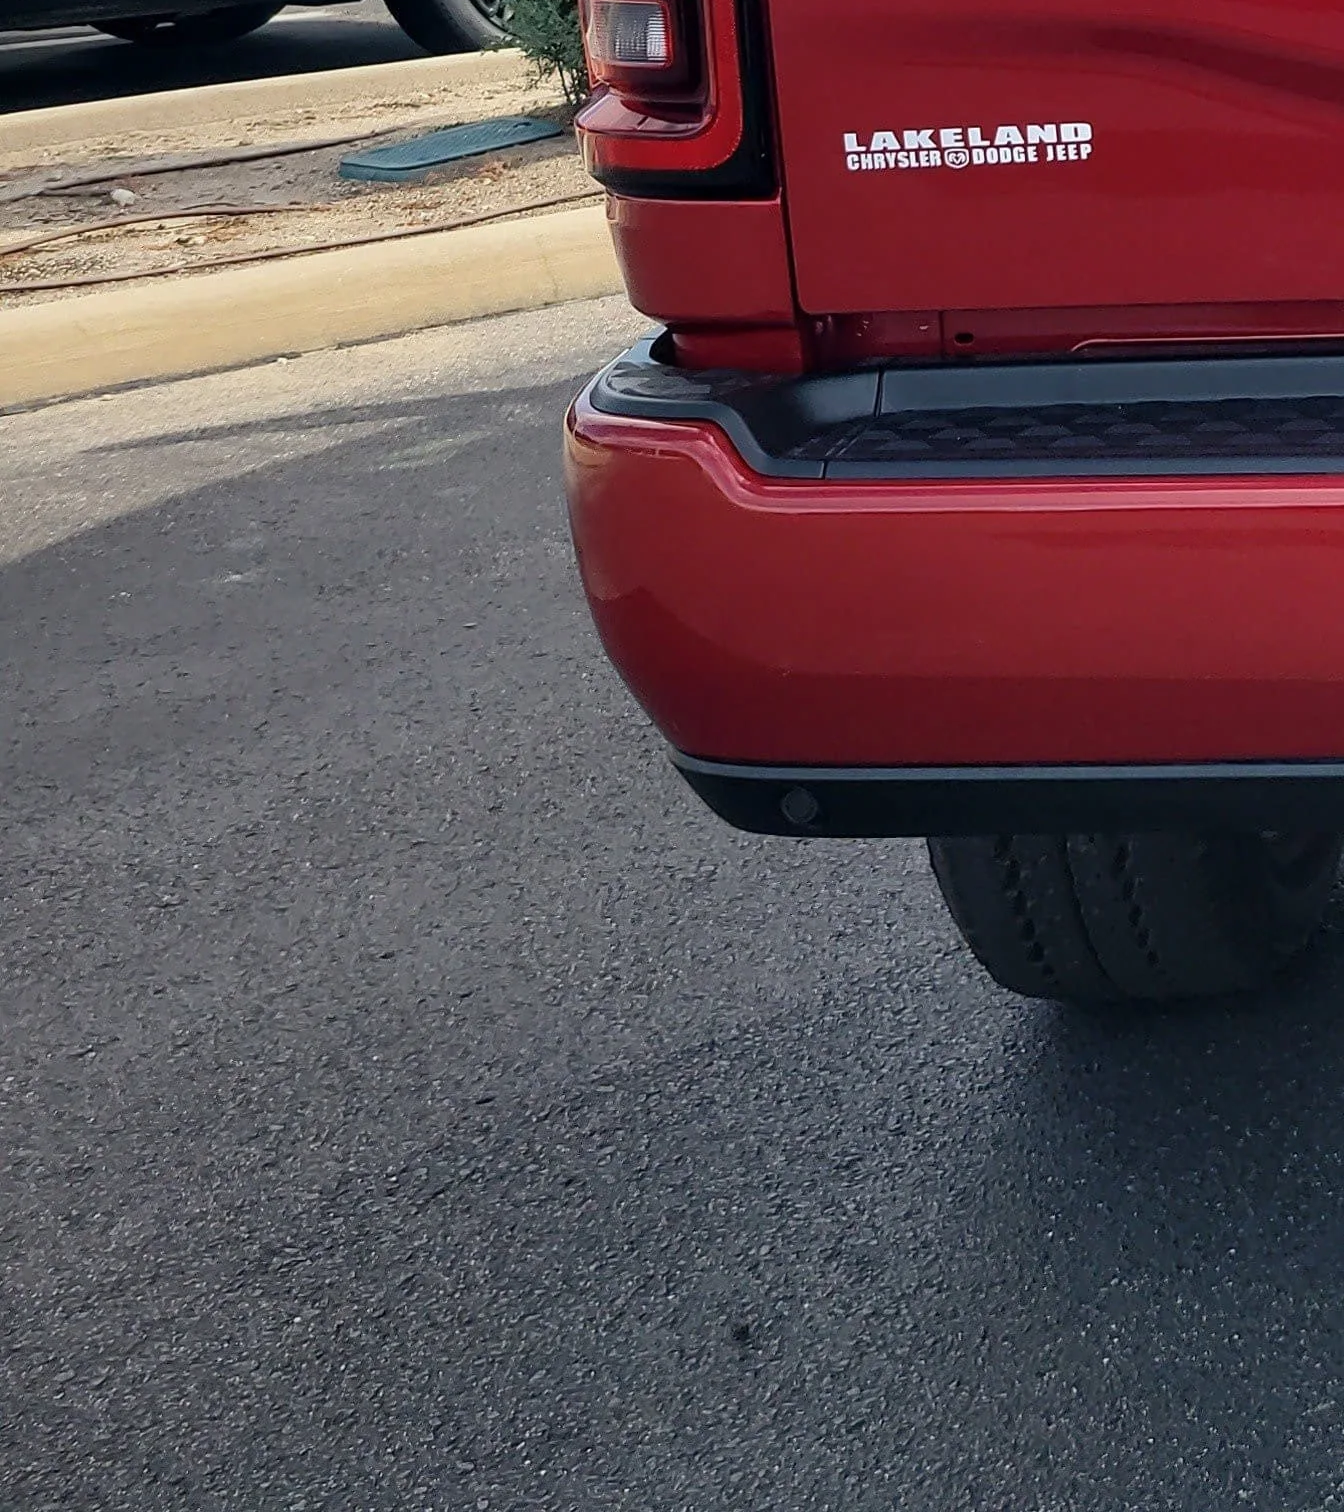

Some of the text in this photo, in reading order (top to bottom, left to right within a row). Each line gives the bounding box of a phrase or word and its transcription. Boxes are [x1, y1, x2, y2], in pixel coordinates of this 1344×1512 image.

[844, 123, 1092, 152] LAKELAND
[847, 144, 1092, 170] CHRYSLER DODGE JEEP
